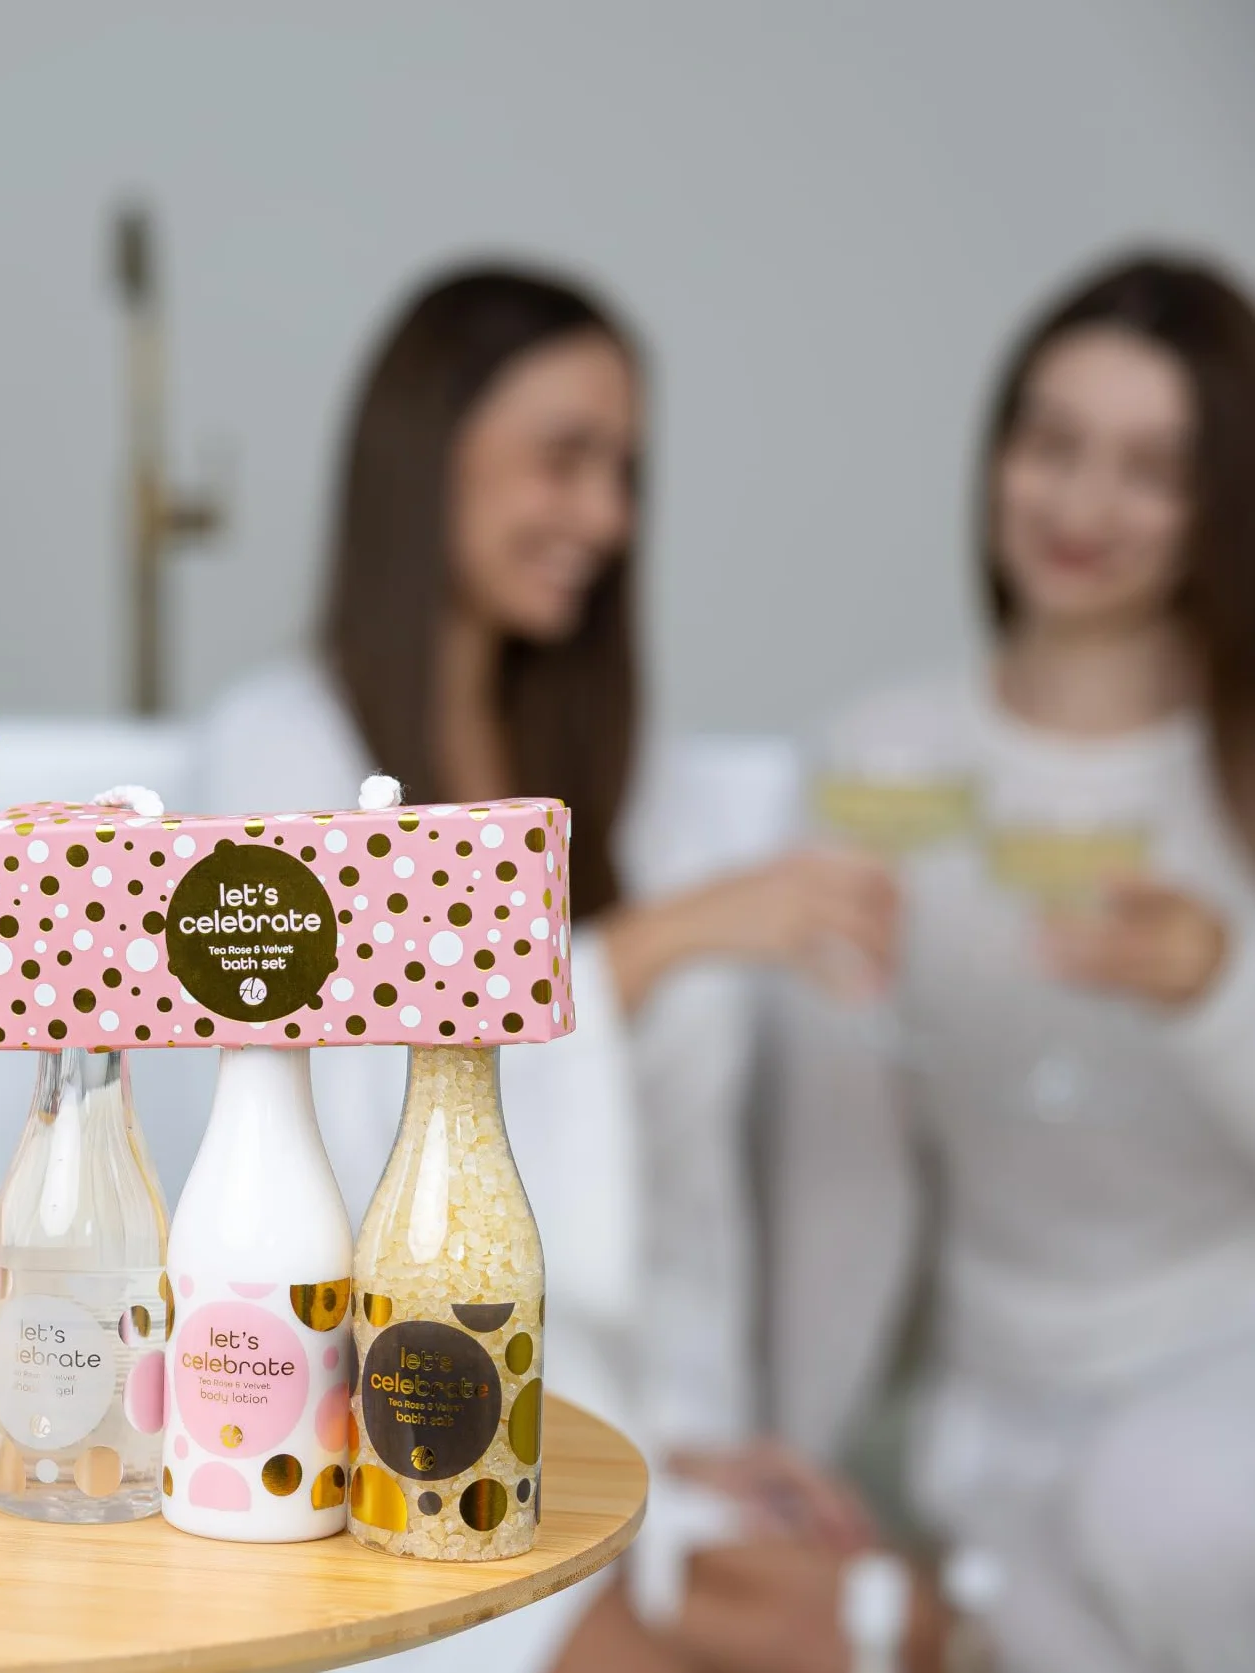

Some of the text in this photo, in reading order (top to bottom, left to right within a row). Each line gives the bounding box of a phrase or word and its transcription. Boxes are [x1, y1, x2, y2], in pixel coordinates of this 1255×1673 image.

[220, 883, 279, 907] let's
[179, 909, 321, 934] celebrate
[208, 946, 227, 955] Tea
[228, 946, 252, 954] Rose
[262, 945, 294, 954] Velvet
[221, 957, 287, 970] bath set
[20, 1319, 65, 1344] let's
[210, 1327, 259, 1351] let's
[182, 1352, 295, 1376] celebrate
[400, 1346, 453, 1372] let's
[55, 1385, 74, 1397] gel
[199, 1377, 211, 1385] Tea
[214, 1379, 233, 1388] Rose
[243, 1382, 271, 1390] Velvet
[370, 1372, 489, 1399] celebrate
[200, 1388, 268, 1404] body lotion
[396, 1411, 426, 1425] bath
